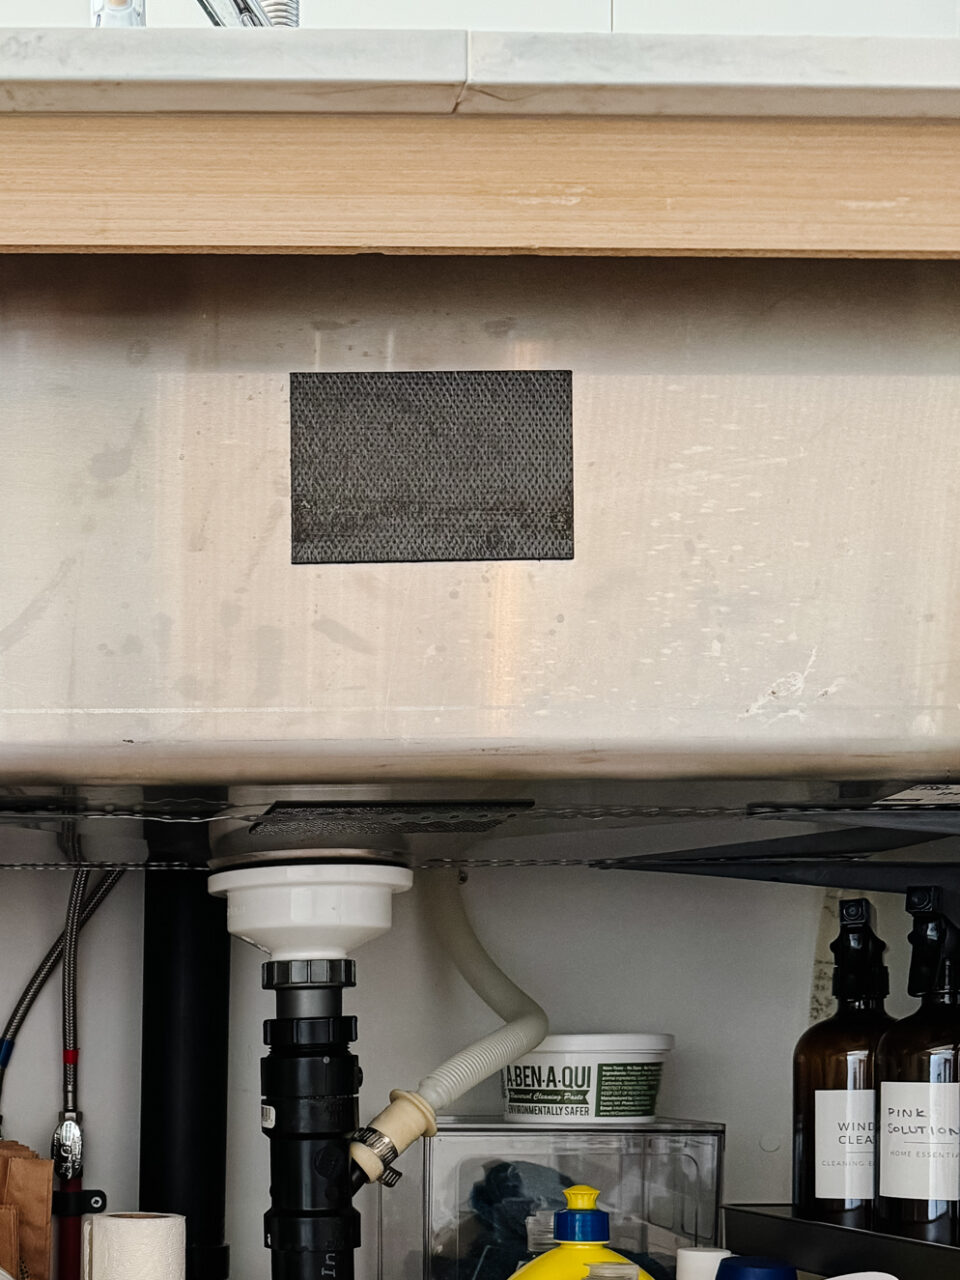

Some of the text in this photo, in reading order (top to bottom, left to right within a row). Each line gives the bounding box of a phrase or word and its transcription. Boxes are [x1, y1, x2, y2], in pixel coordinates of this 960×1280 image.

[564, 1106, 590, 1116] SAFER
[888, 1107, 927, 1118] PINK
[837, 1122, 874, 1131] WIND
[888, 1122, 960, 1135] SOLUTION
[838, 1135, 874, 1145] CLEA
[890, 1150, 913, 1158] HOME
[320, 1252, 337, 1278] In
